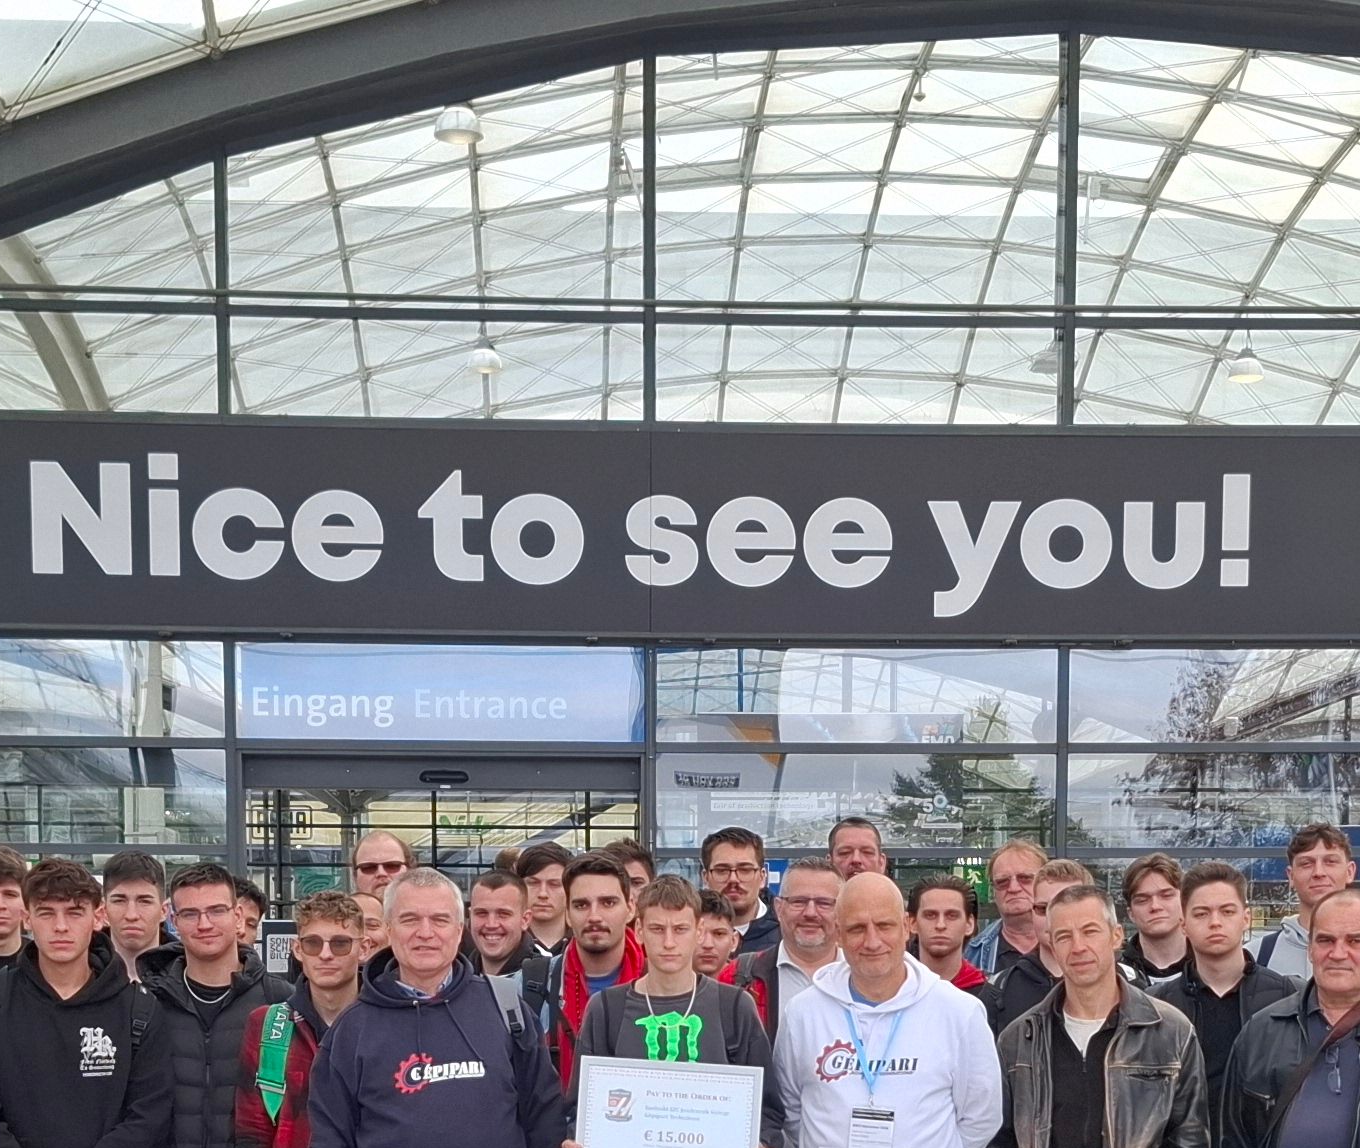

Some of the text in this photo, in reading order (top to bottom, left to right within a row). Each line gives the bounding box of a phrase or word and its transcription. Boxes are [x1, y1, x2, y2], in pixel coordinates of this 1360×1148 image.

[30, 453, 1251, 617] Nice to see you!
[251, 685, 567, 728] Eingang Entrance
[644, 1130, 705, 1145] € 15.000
